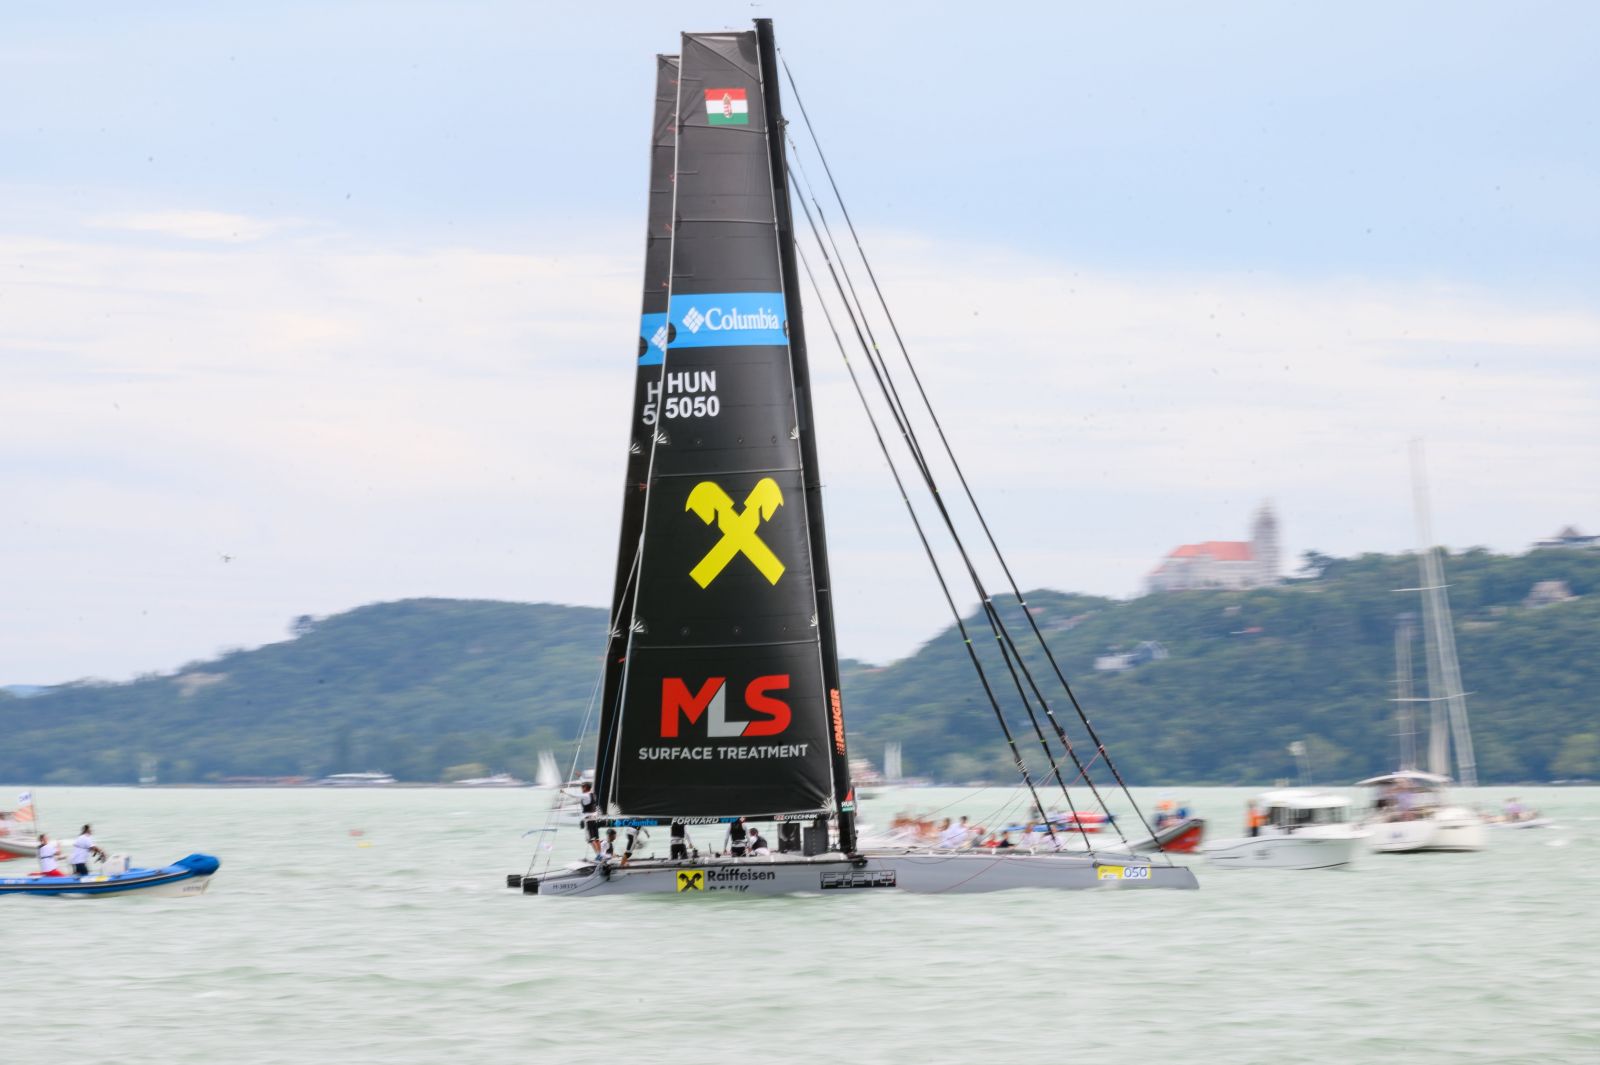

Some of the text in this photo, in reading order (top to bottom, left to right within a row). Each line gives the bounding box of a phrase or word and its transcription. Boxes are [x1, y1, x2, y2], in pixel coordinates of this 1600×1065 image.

[704, 308, 779, 330] Columbia
[667, 370, 717, 394] HUN
[665, 396, 720, 418] 5050
[660, 674, 792, 738] MLS
[830, 688, 845, 744] PAUGER
[638, 744, 808, 760] SURFACE TREATMENT
[671, 816, 720, 825] FORWARD
[707, 868, 776, 882] Raiffeisen
[822, 872, 895, 888] FIFTY
[1124, 866, 1148, 878] 050
